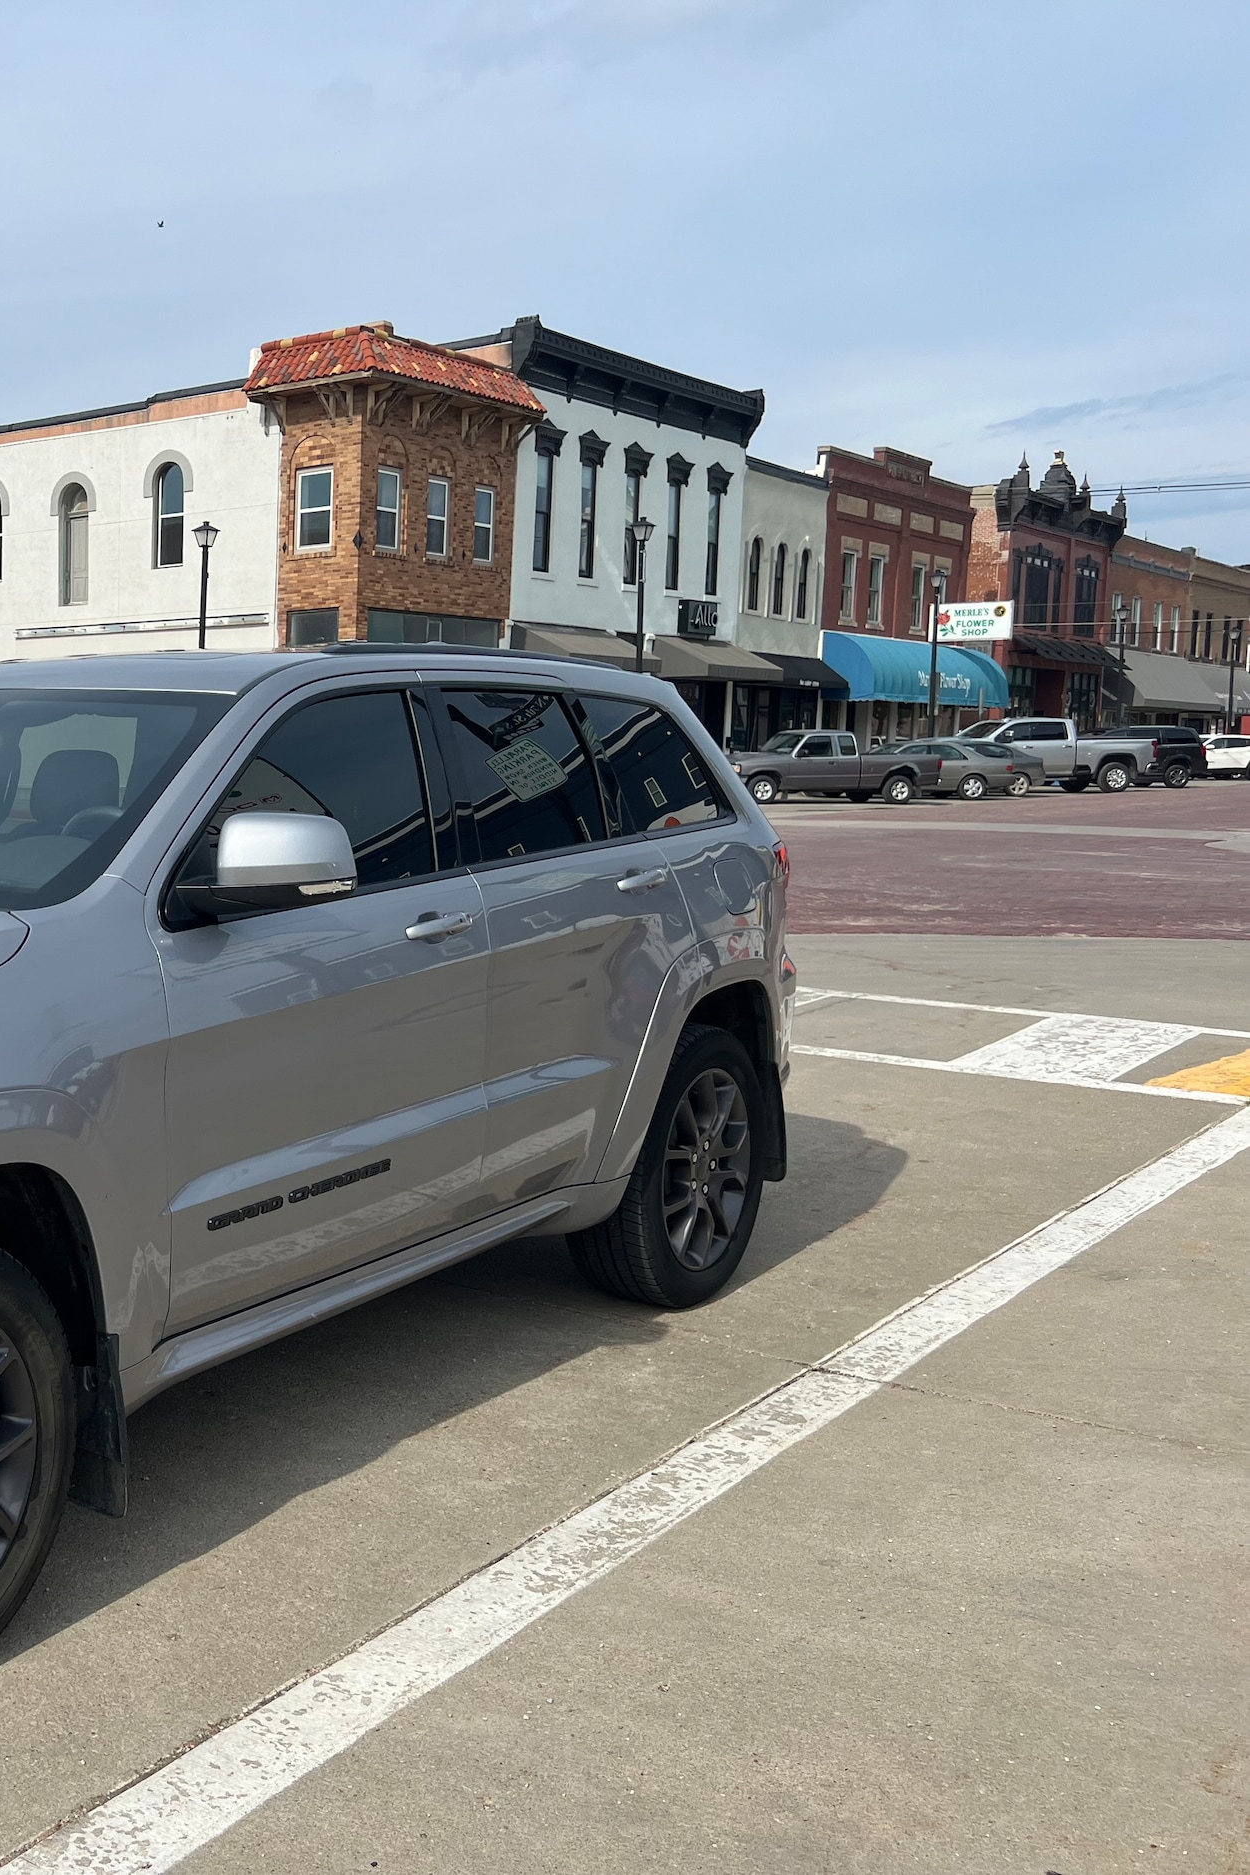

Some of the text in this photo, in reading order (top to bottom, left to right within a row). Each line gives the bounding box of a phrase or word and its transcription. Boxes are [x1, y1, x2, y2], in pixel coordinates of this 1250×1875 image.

[954, 607, 989, 617] MERLE'S
[956, 619, 994, 628] FLOWER
[961, 628, 988, 637] SHOP
[207, 1158, 391, 1231] GRAND CHEROKEE
